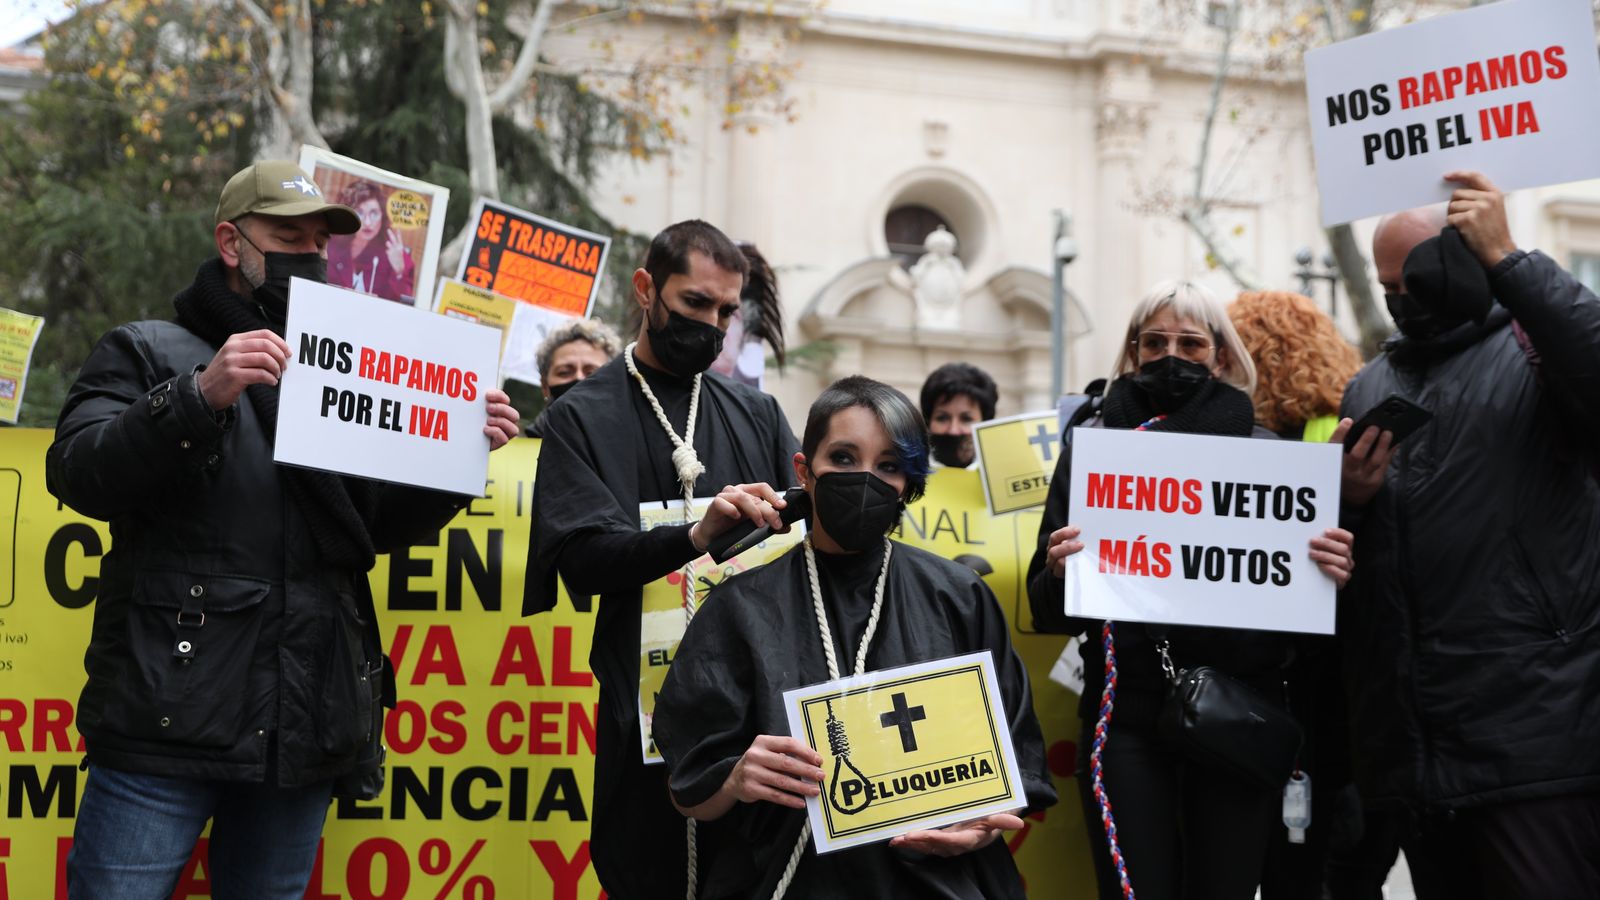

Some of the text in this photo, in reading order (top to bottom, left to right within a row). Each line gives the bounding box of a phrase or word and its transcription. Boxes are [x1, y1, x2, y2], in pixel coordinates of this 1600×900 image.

[1327, 45, 1568, 127] NOS RAPAMOS
[1364, 101, 1540, 166] POR EL IVA
[477, 210, 600, 275] SE TRASPASA
[298, 332, 478, 402] NOS RAPAMOS
[321, 386, 449, 442] POR EL IVA
[1086, 473, 1316, 523] MENOS VETOS
[1099, 536, 1292, 587] MÁS VOTOS
[841, 757, 994, 807] PELUQUERÍA
